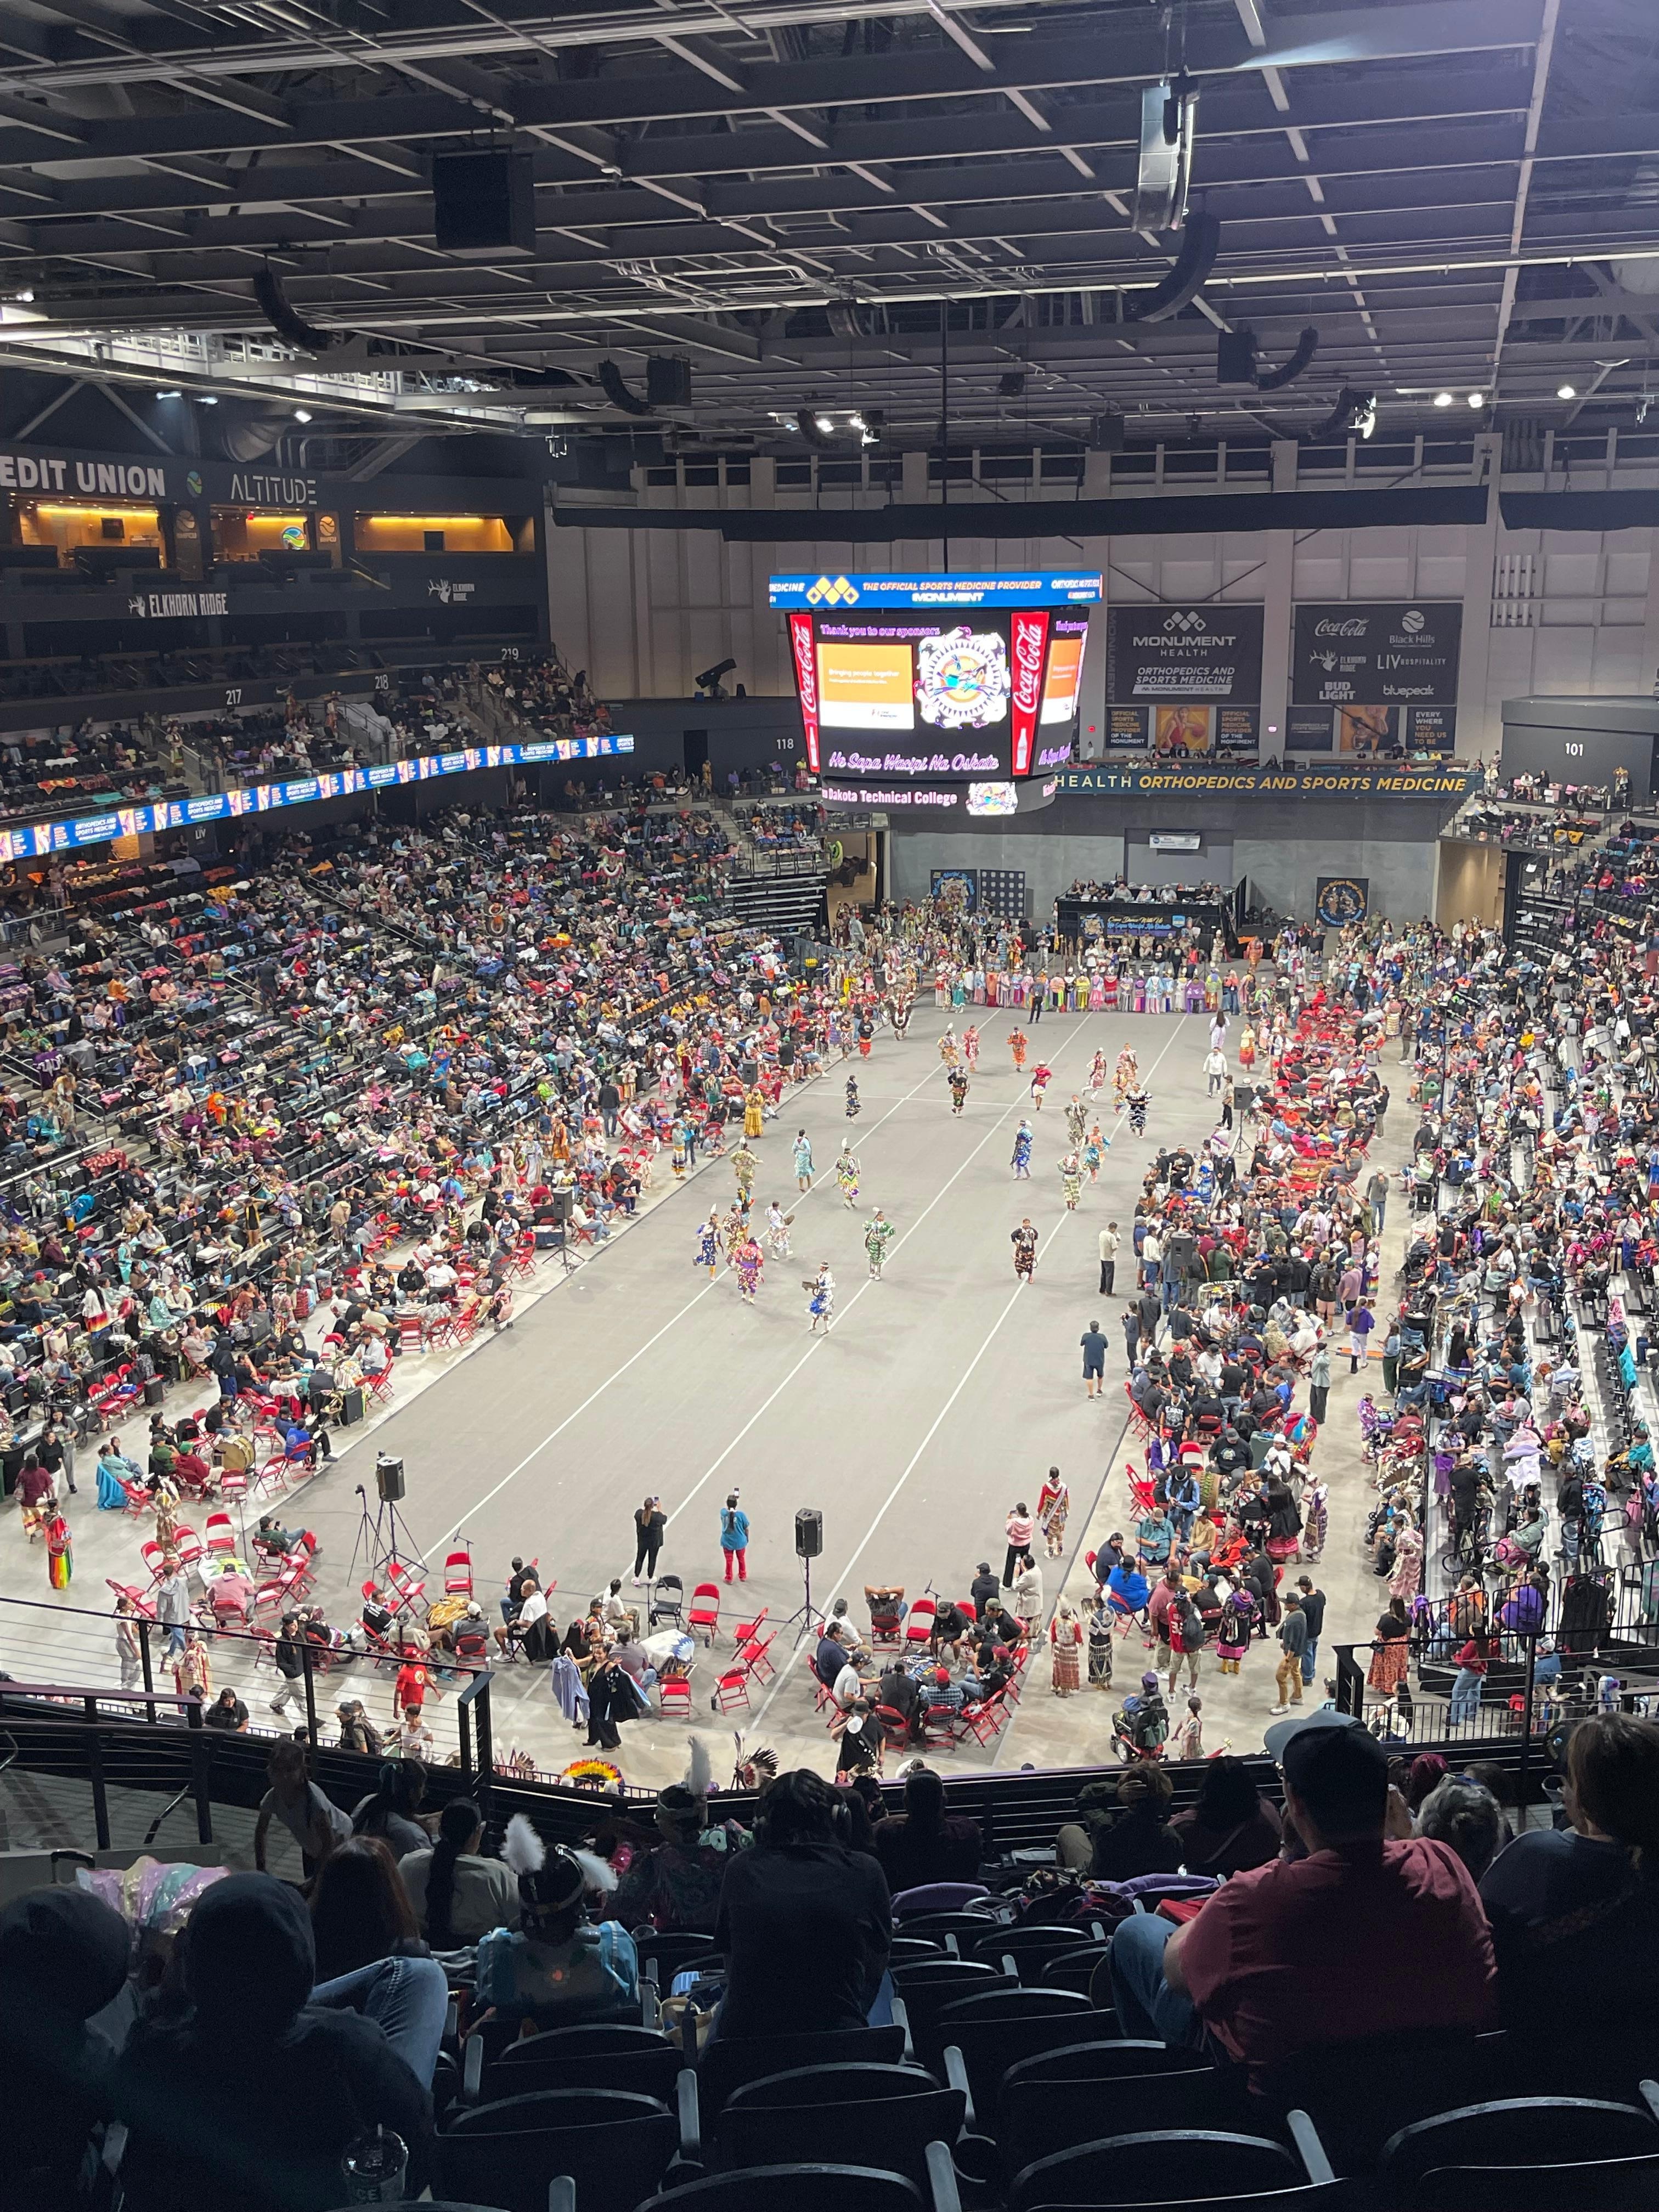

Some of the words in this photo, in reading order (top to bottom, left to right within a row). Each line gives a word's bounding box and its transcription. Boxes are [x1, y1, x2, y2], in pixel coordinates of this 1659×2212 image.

[0, 456, 66, 490] EDIT
[76, 462, 166, 496] UNION
[231, 474, 317, 505] ALTITUDE
[862, 582, 878, 591] THE
[880, 582, 918, 591] OFFICIAL
[920, 582, 952, 591] SPORTS
[955, 582, 996, 590] MEDICINE
[997, 581, 1042, 590] PROVIDER
[912, 592, 984, 602] MONUMENT
[149, 594, 198, 617] ELKHORN
[199, 593, 229, 615] RIDGE
[820, 624, 849, 635] Thank
[849, 627, 867, 638] you
[867, 626, 878, 636] to
[879, 627, 896, 636] our
[896, 627, 940, 639] sponsors
[1133, 636, 1236, 646] MONUMENT
[1389, 635, 1414, 644] Black
[1415, 635, 1435, 644] Hills
[501, 648, 519, 660] 219
[1377, 654, 1401, 669] LIV
[1137, 667, 1209, 675] ORTHOPEDICS
[1212, 667, 1235, 675] AND
[375, 674, 389, 690] 218
[1136, 676, 1177, 684] SPORTS
[1180, 676, 1233, 684] MEDICINE
[1324, 682, 1351, 691] BUD
[225, 689, 241, 705] 217
[1319, 691, 1356, 700] LIGHT
[1383, 685, 1435, 698] bluepeak
[777, 738, 794, 749] 118
[1566, 743, 1583, 756] 101
[829, 751, 847, 768] He
[848, 752, 882, 774] Sapa
[884, 754, 928, 775] Wacipi
[929, 754, 950, 771] Na
[952, 753, 1000, 771] Oskate
[1054, 775, 1132, 788] HEALTH
[1139, 775, 1256, 789] ORTHOPEDICS
[1259, 777, 1297, 790] AND
[1300, 777, 1372, 790] SPORTS
[1376, 777, 1467, 792] MEDICINE
[828, 788, 857, 802] Dakota
[860, 790, 912, 804] Technical
[915, 791, 958, 806] College
[195, 828, 206, 839] LIV
